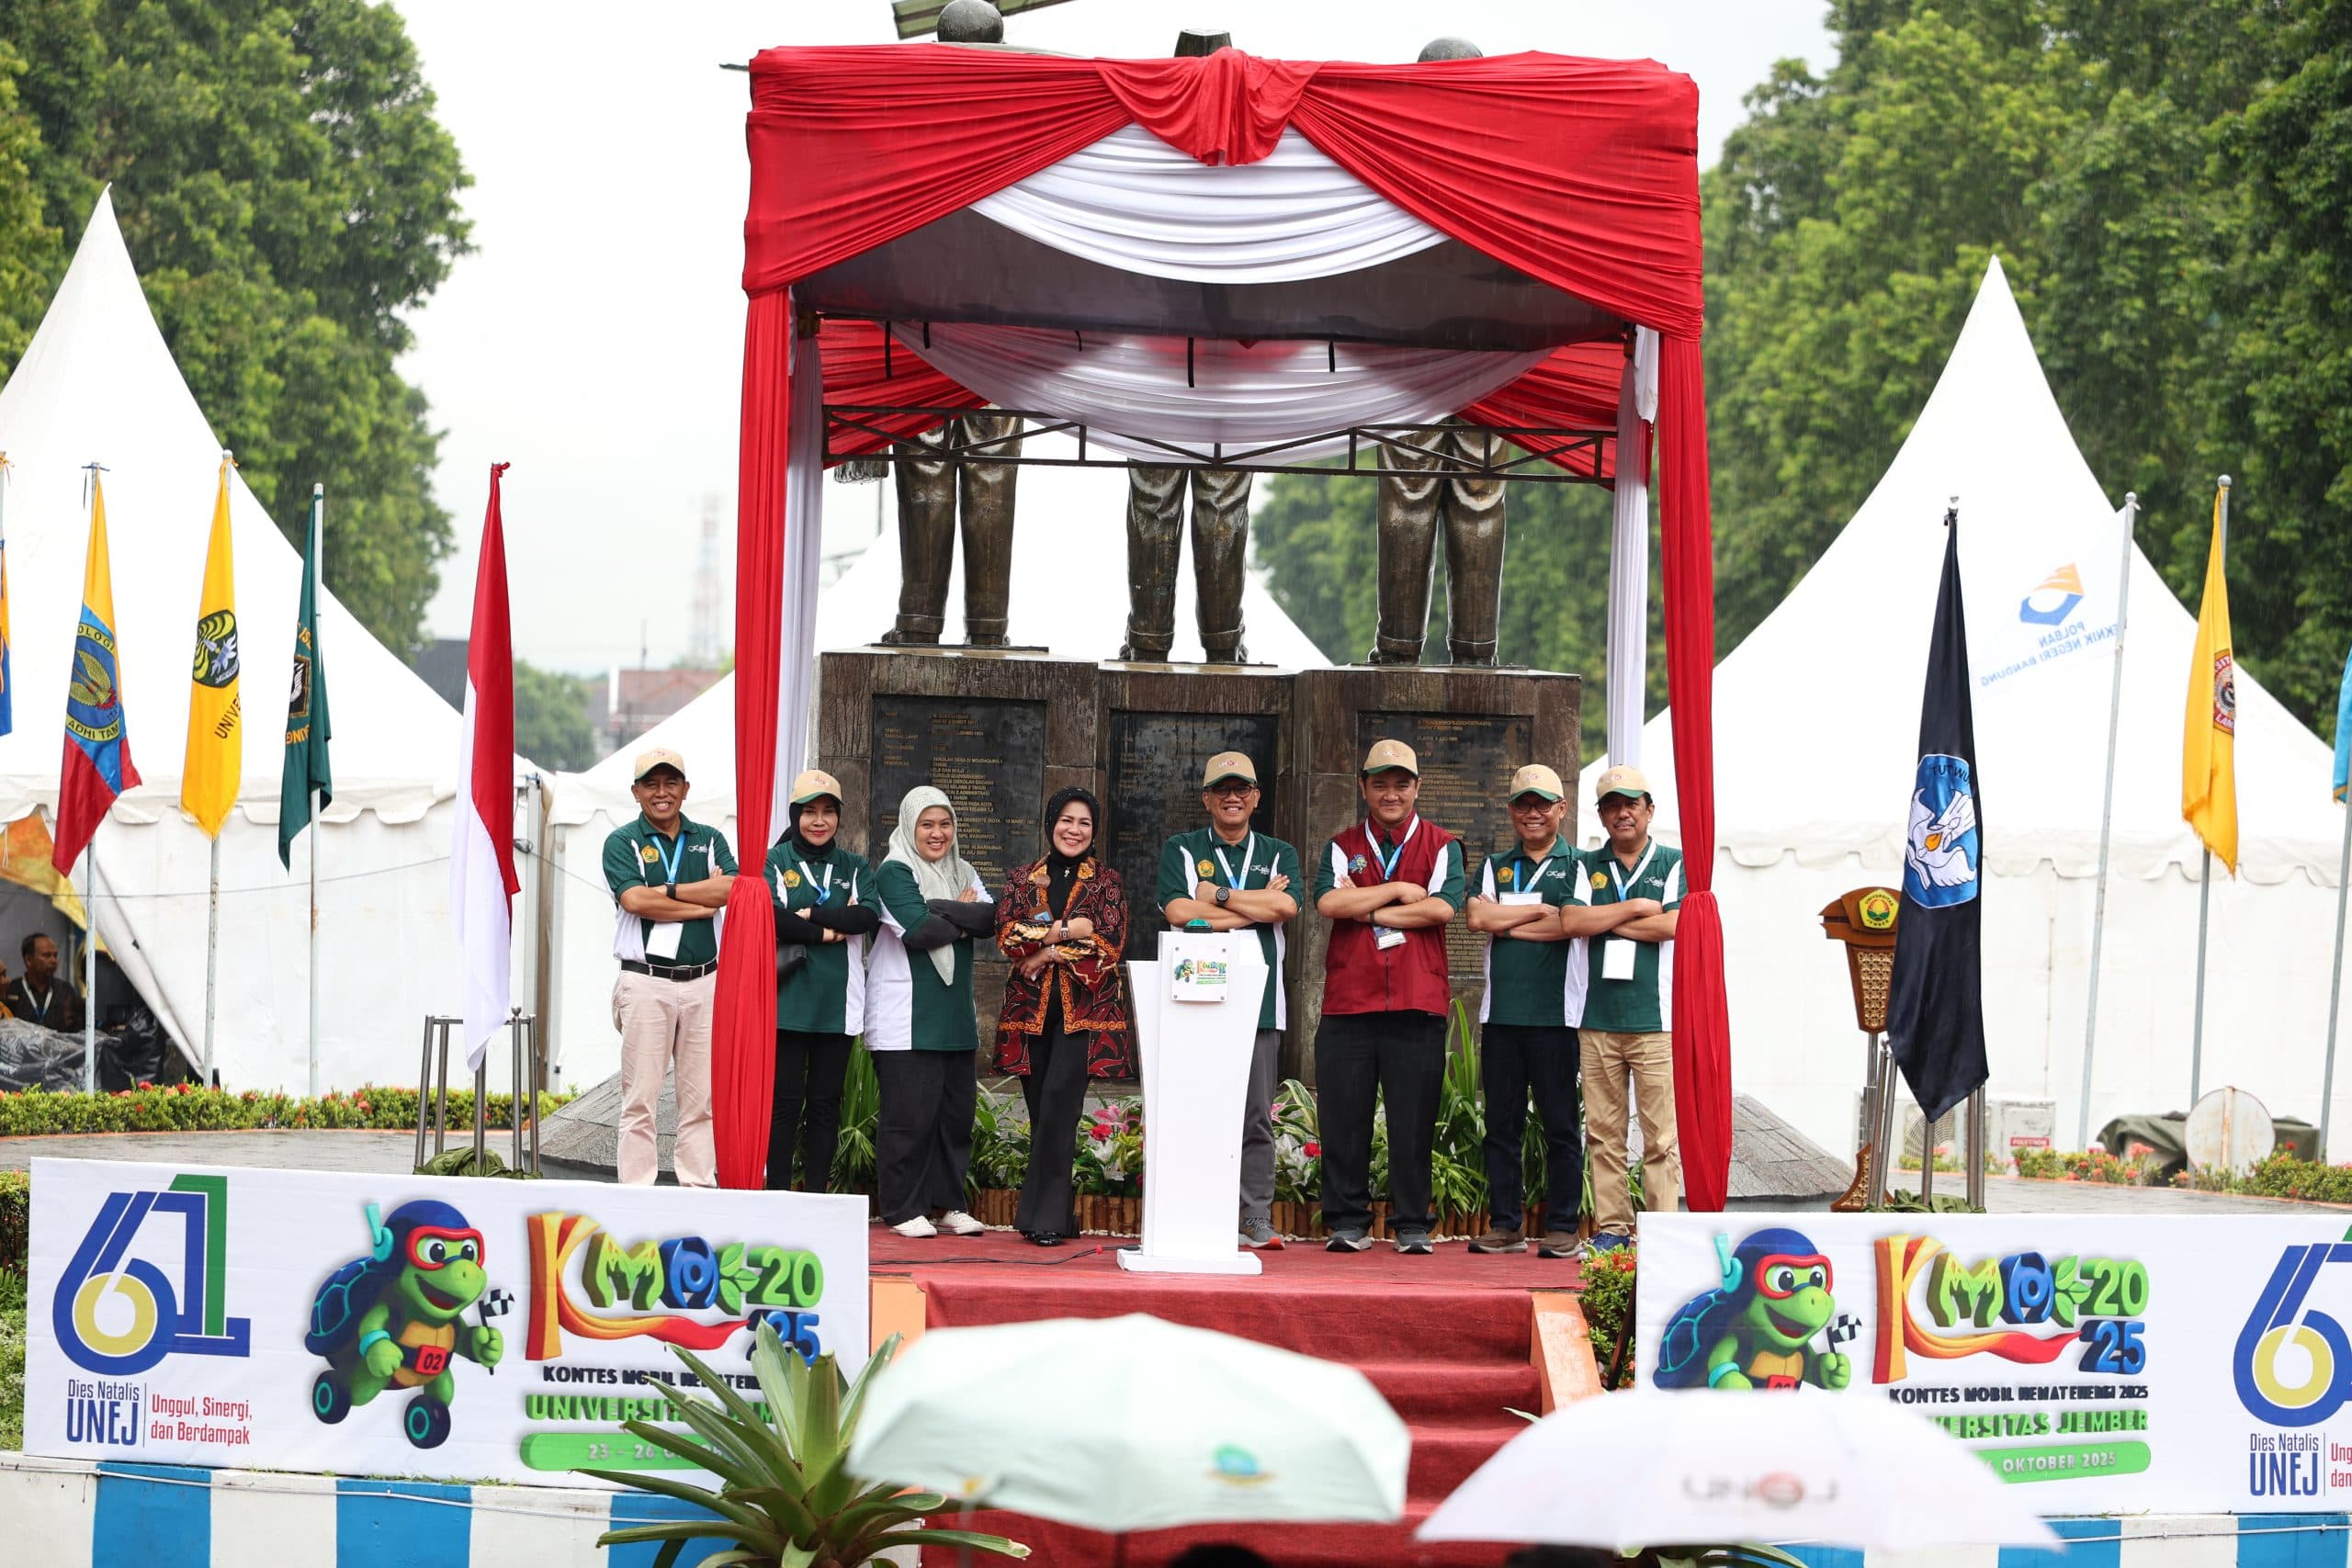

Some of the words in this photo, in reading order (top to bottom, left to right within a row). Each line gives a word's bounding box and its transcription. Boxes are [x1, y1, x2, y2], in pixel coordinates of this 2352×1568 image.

[68, 720, 96, 739] ADHI
[1931, 764, 1953, 777] TUT
[2078, 1319, 2146, 1375] 25
[424, 1353, 444, 1371] 02
[543, 1366, 617, 1384] KONTES
[68, 1379, 94, 1398] Dies
[97, 1381, 140, 1401] Natalis
[1889, 1387, 1960, 1404] KONTES
[1964, 1387, 2015, 1402] MOBIL
[152, 1393, 198, 1418] Unggul,
[202, 1396, 253, 1421] Sinergi,
[67, 1398, 139, 1446] UNEJ
[2056, 1410, 2148, 1435] JEMBER
[151, 1420, 174, 1440] dan
[177, 1421, 250, 1447] Berdampak
[2250, 1433, 2275, 1451] Dies
[2278, 1433, 2319, 1451] Natalis
[588, 1443, 610, 1461] 23
[634, 1443, 655, 1460] 26
[2002, 1454, 2075, 1473] OKTOBER
[2082, 1452, 2117, 1468] 2025
[2249, 1452, 2318, 1496] UNEJ
